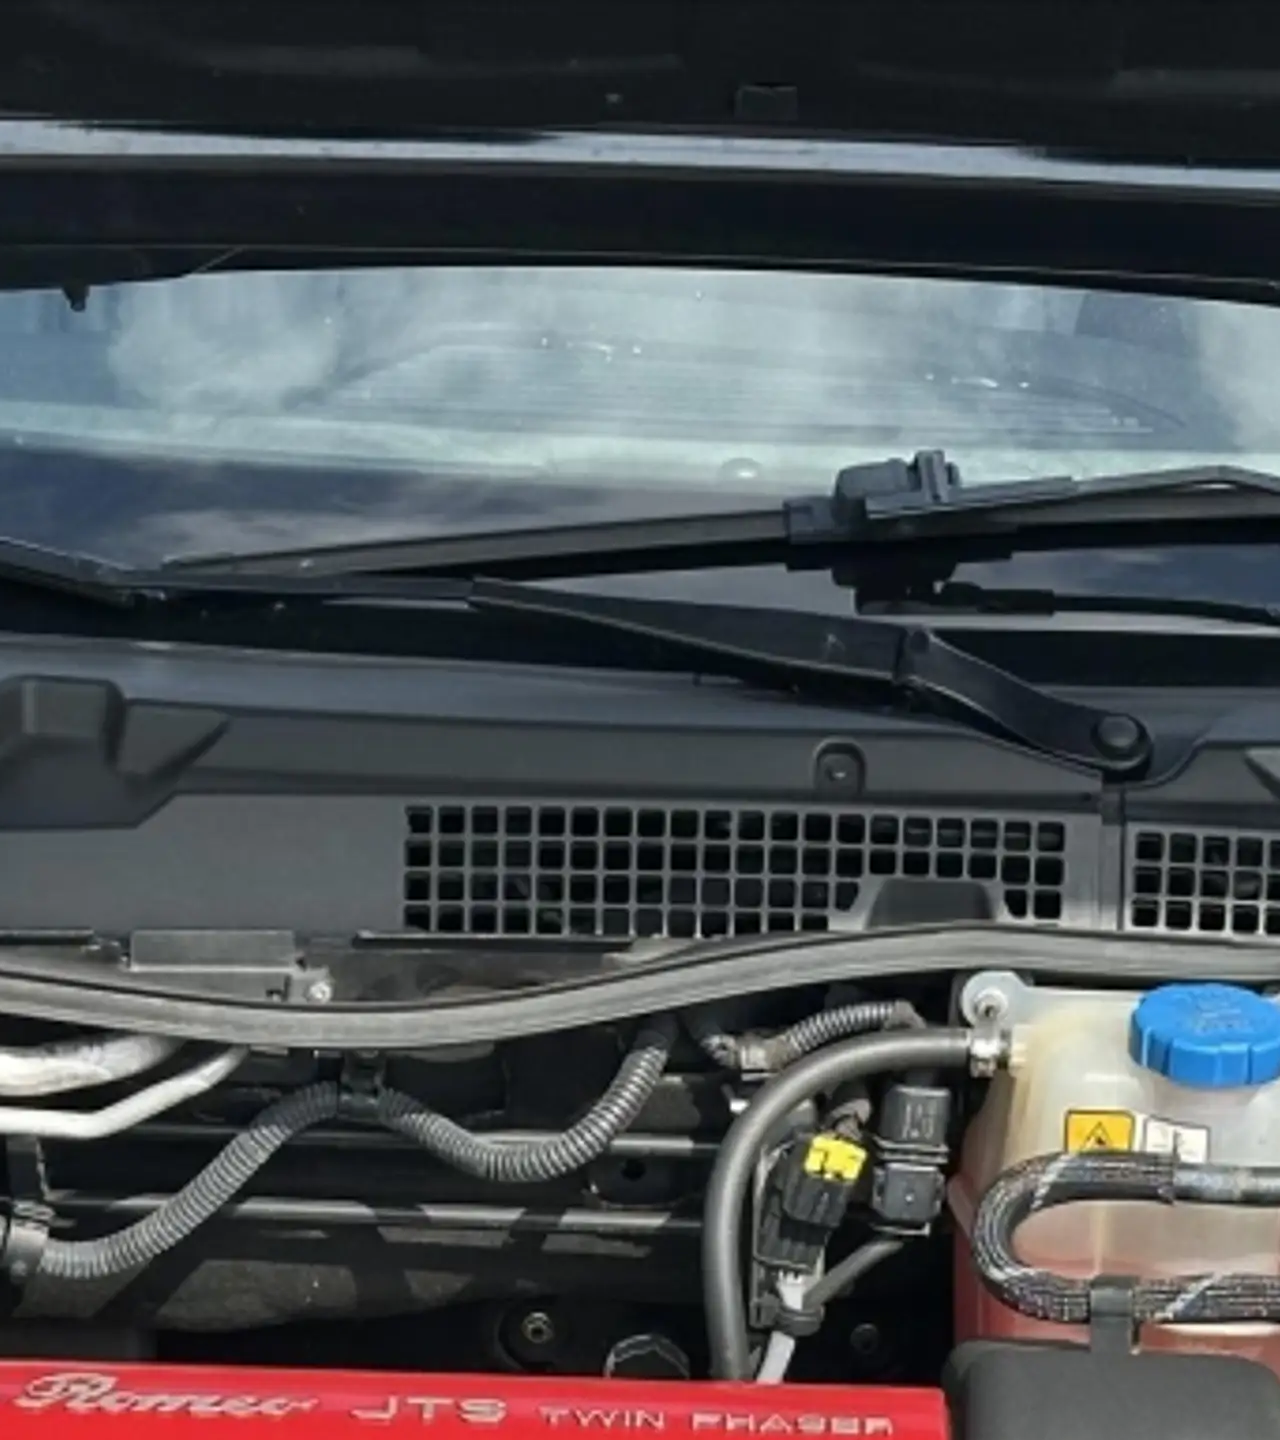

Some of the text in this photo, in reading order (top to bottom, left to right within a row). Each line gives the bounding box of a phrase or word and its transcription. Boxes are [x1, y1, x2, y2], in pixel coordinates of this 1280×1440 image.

[15, 1372, 320, 1416] Romeo
[350, 1395, 508, 1425] JTS
[540, 1405, 665, 1431] TWIN
[690, 1411, 894, 1436] PHASER
